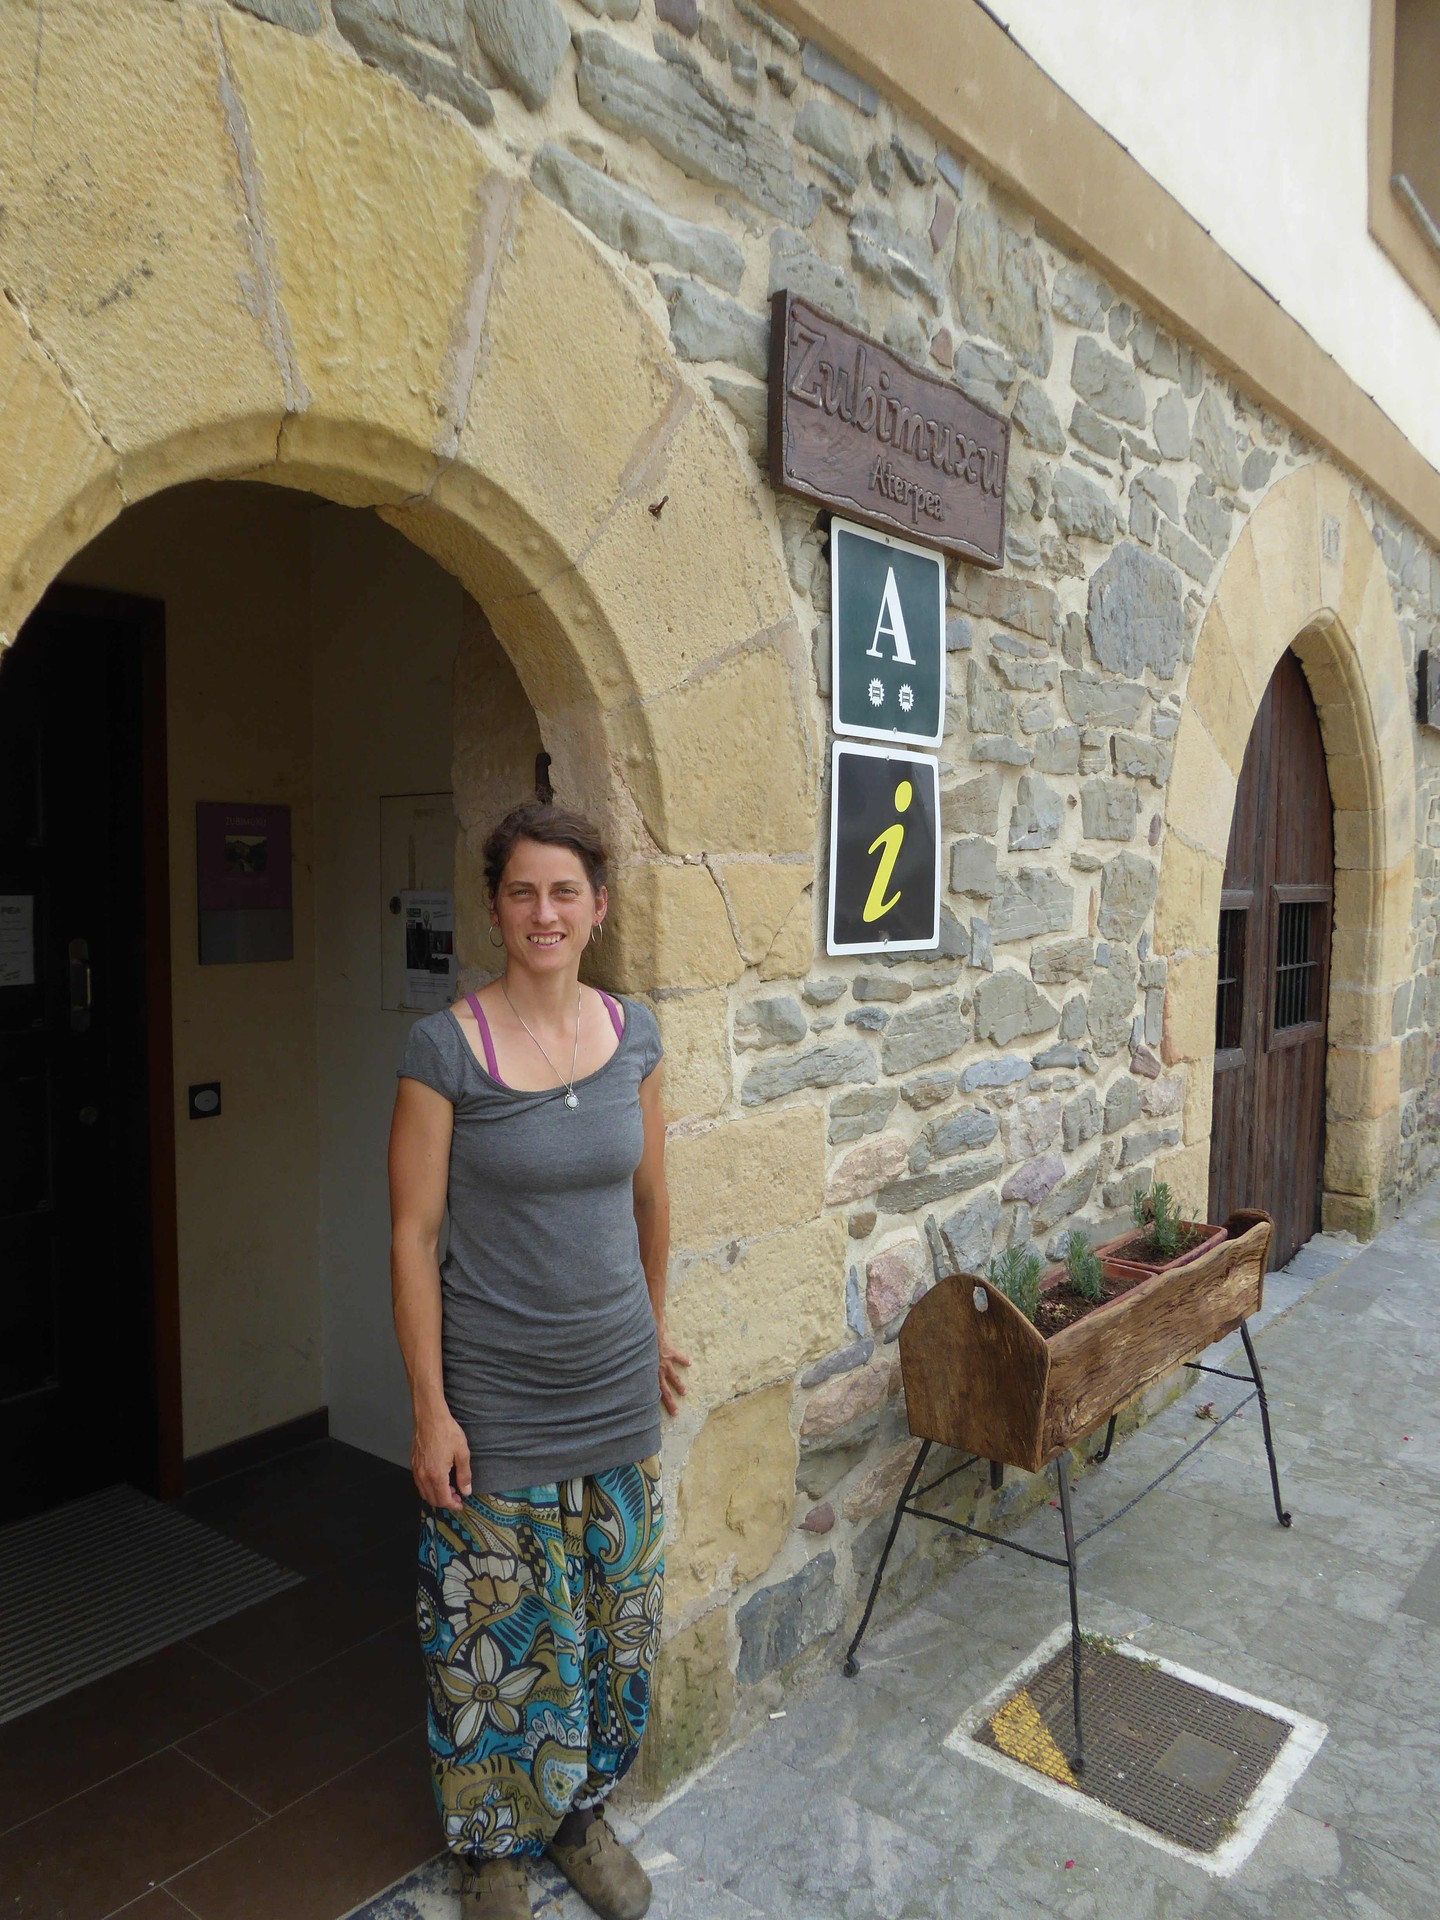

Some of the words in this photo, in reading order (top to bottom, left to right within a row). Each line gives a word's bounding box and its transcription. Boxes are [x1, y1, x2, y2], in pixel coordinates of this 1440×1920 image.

[788, 321, 1003, 498] Zubimuxu
[868, 455, 944, 524] Aterpea
[866, 566, 916, 665] A
[862, 781, 913, 922] i
